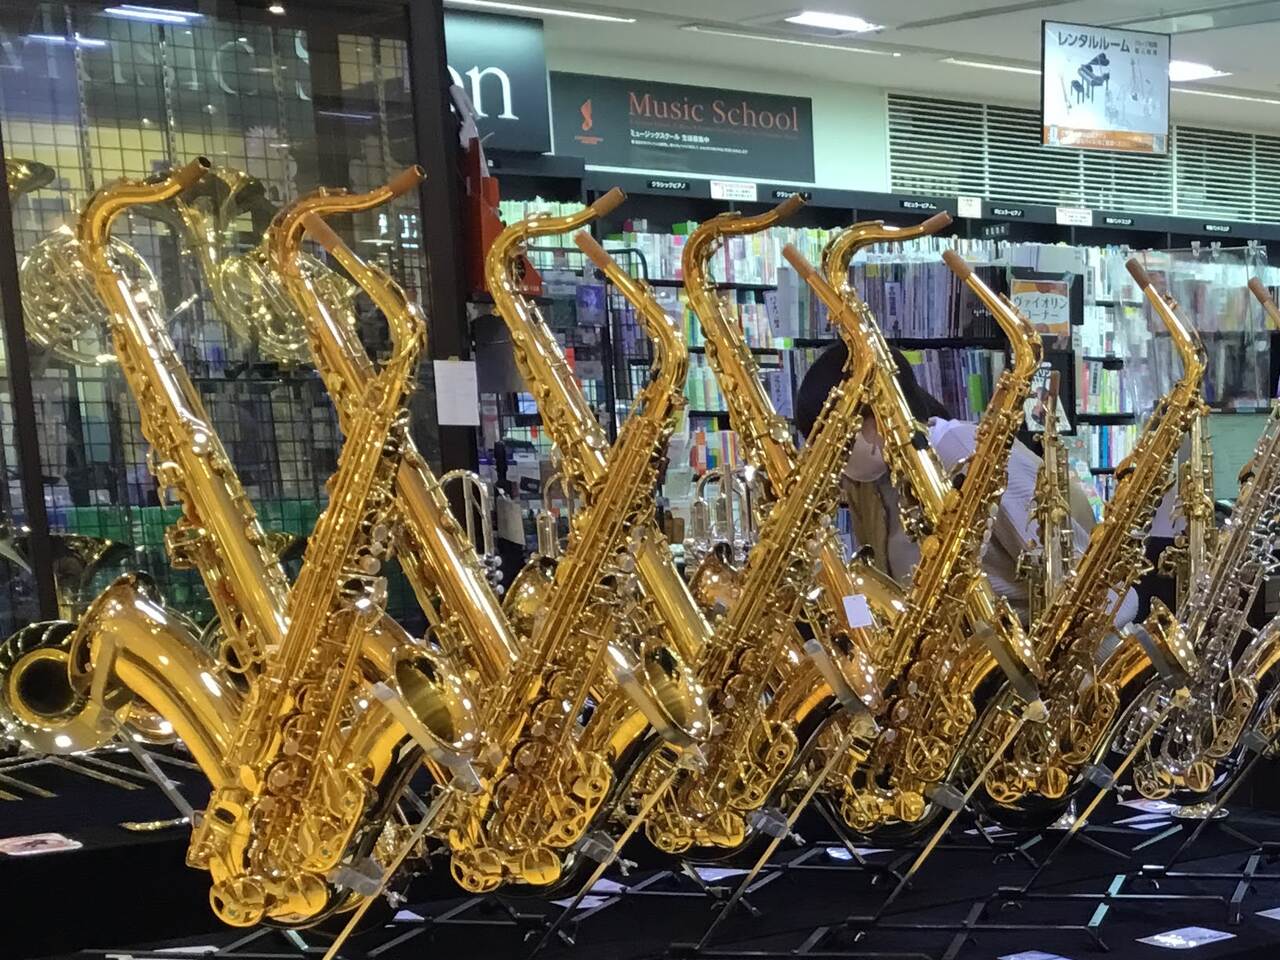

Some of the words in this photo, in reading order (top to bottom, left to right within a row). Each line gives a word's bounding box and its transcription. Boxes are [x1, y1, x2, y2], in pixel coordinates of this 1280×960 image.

[1058, 31, 1130, 53] レンタルルーム
[629, 91, 705, 122] Music
[712, 100, 799, 132] School
[1014, 295, 1067, 309] ヴァイオリン
[1024, 309, 1059, 320] コーナー
